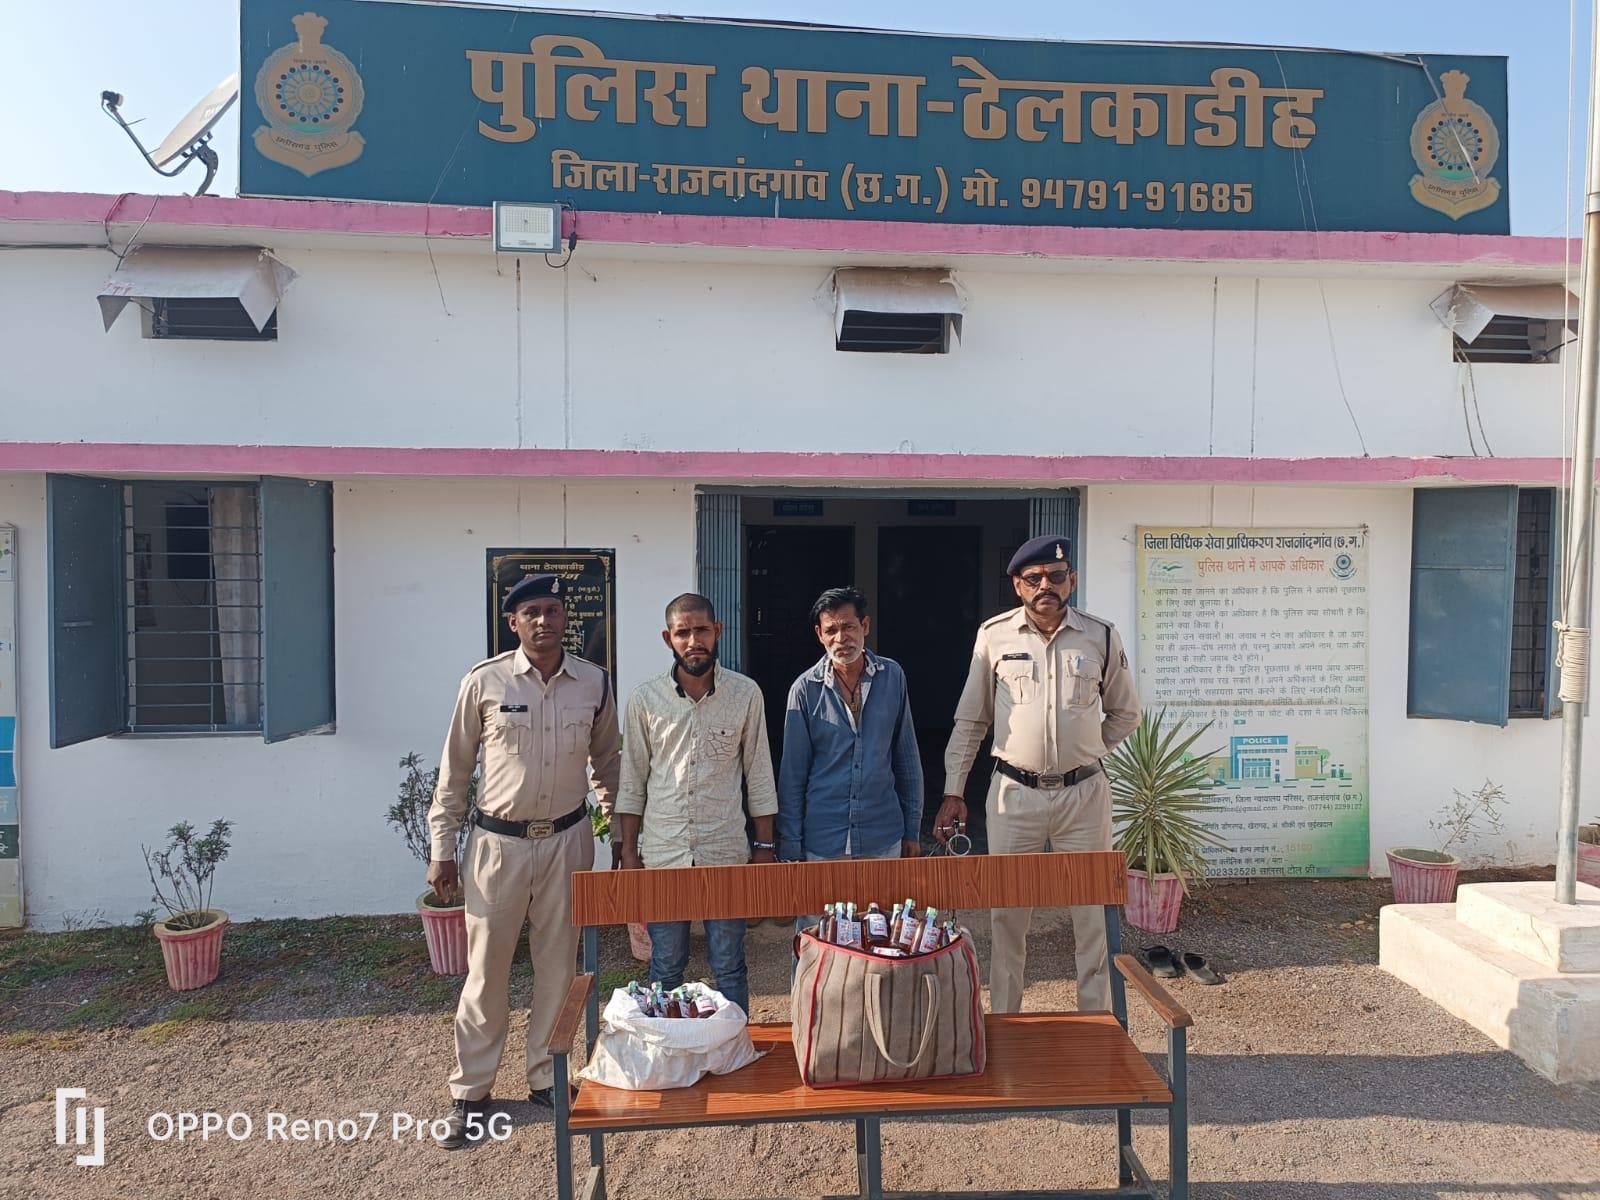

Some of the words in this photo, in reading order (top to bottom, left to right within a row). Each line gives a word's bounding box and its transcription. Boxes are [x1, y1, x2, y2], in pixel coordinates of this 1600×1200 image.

[465, 34, 717, 143] पुलिस
[741, 55, 1325, 149] थाना-ठेलकाडीह
[551, 150, 830, 201] जिला-राजनांदगांव
[840, 162, 949, 214] (छ.ग.)
[961, 168, 1008, 208] मो.
[1020, 178, 1253, 214] 94791-91685
[1144, 533, 1168, 550] जिला
[1170, 533, 1203, 550] विधिक
[1205, 533, 1225, 550] सेवा
[1226, 533, 1273, 550] प्राधिकरण
[1276, 532, 1332, 549] राजनांदगांव
[1334, 534, 1365, 549] (छ.ग.)
[1198, 557, 1223, 577] पुलिस
[1227, 557, 1245, 573] थाने
[1260, 555, 1286, 572] आपके
[1290, 556, 1324, 571] अधिकार
[1155, 588, 1178, 596] आपको
[1182, 588, 1192, 596] यह
[1232, 586, 1258, 595] अधिकार
[1262, 586, 1267, 594] है
[1270, 586, 1280, 594] कि
[1283, 585, 1303, 596] पुलिस
[1316, 586, 1337, 594] आपको
[1166, 599, 1180, 608] लिए
[1155, 610, 1178, 618] आपको
[1182, 610, 1192, 618] यह
[1232, 609, 1258, 617] अधिकार
[1270, 608, 1280, 616] कि
[1283, 607, 1303, 619] पुलिस
[1155, 633, 1179, 641] आपको
[1298, 630, 1325, 639] अधिकार
[1183, 665, 1213, 673] अधिकार
[1239, 664, 1260, 674] पुलिस
[1264, 664, 1289, 674] पूछताछ
[1291, 685, 1305, 695] लिए
